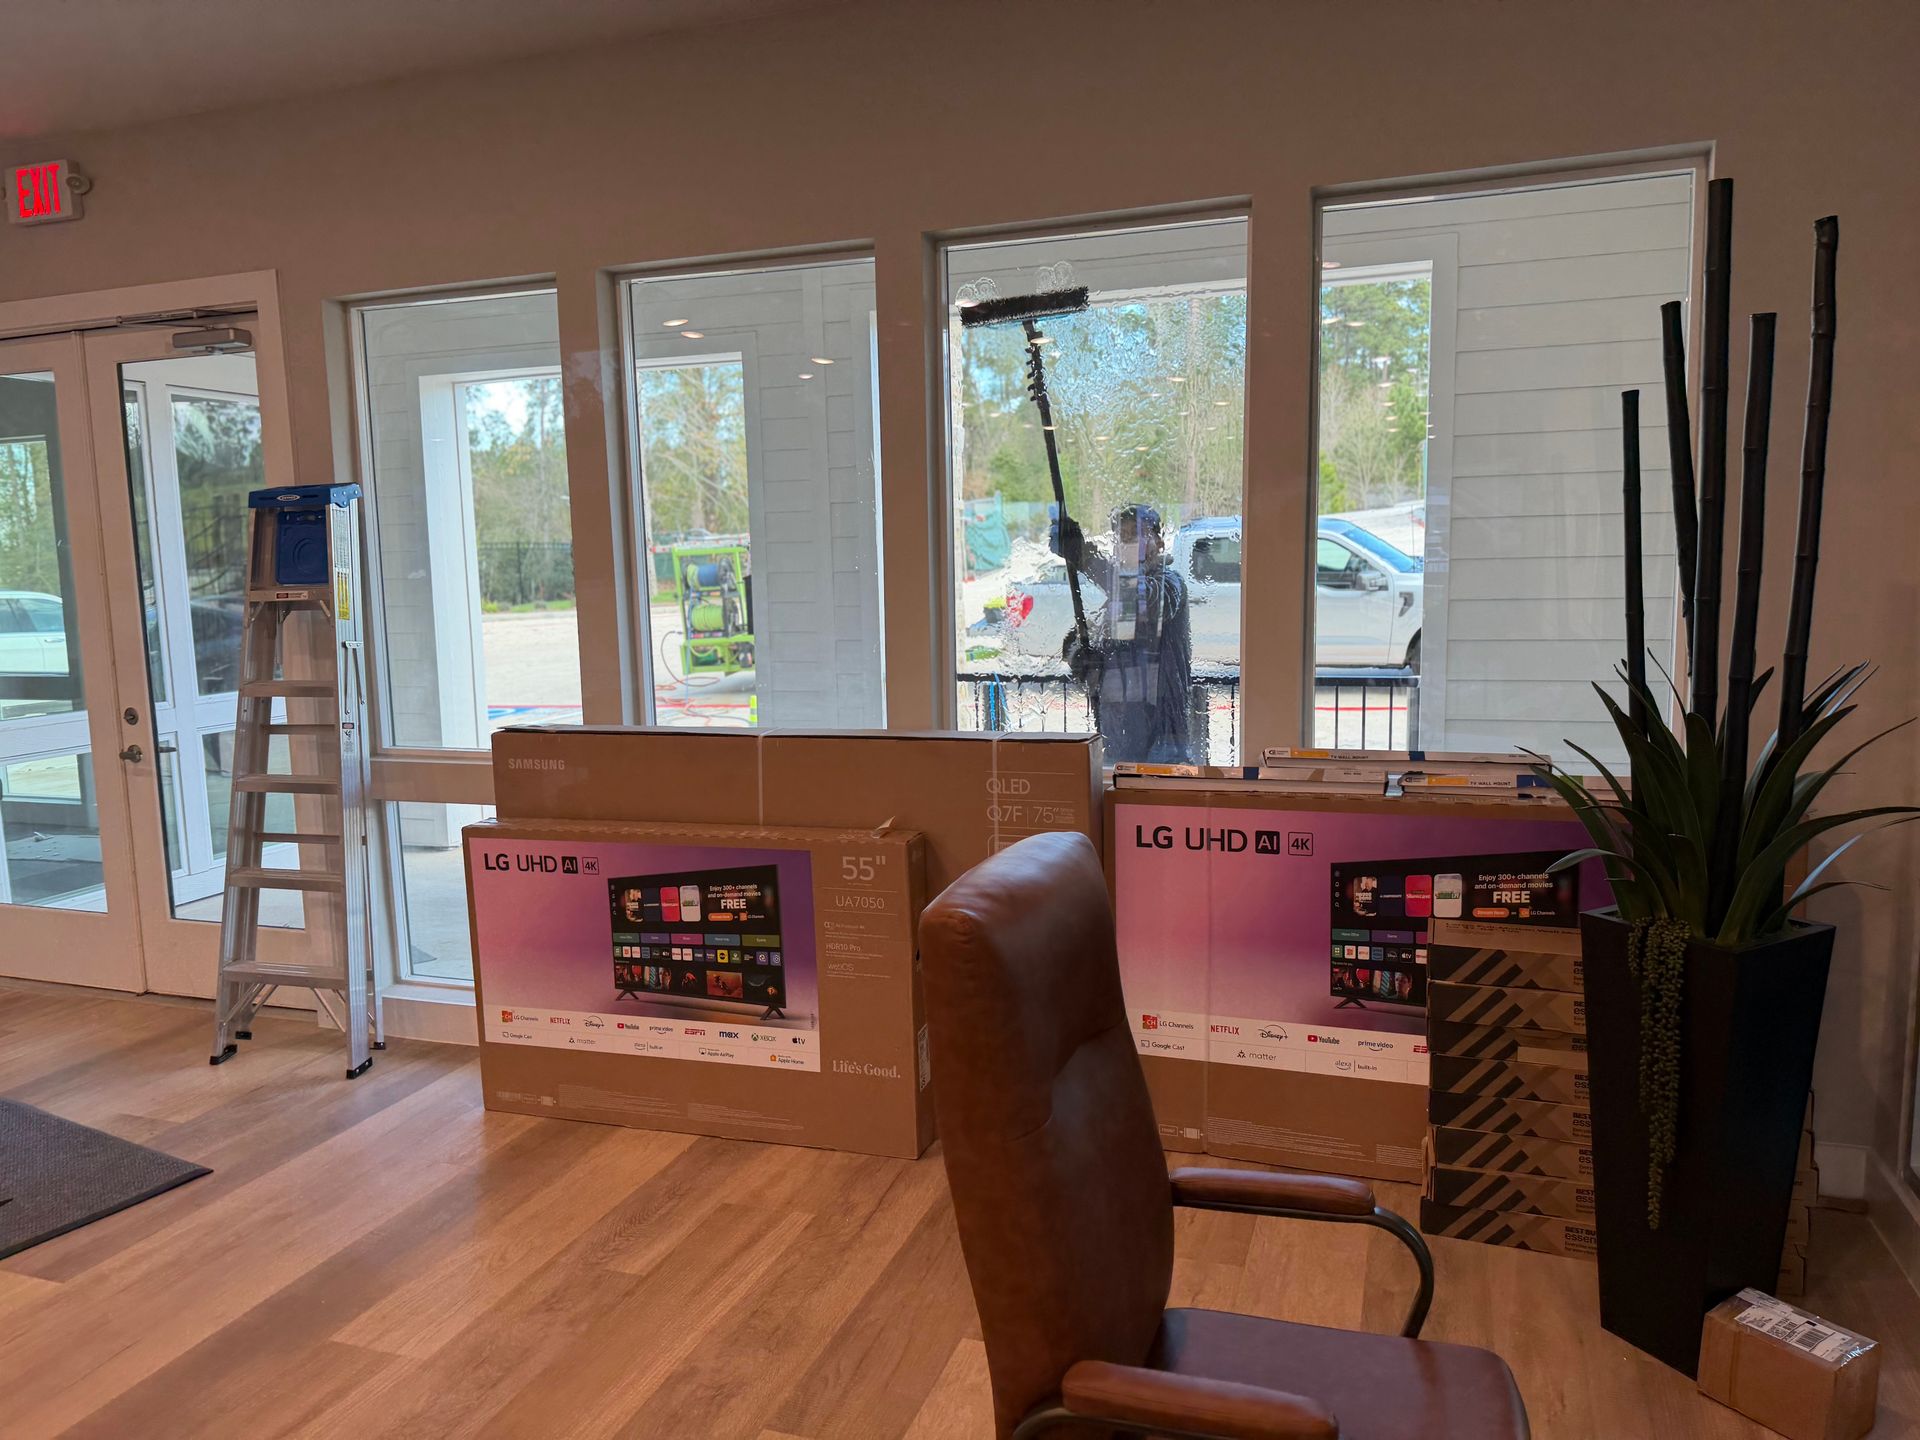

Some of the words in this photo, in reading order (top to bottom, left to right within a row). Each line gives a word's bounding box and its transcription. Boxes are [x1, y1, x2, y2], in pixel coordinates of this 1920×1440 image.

[16, 163, 61, 218] EXIT
[508, 758, 565, 770] SAMSUNG
[986, 778, 1030, 795] QLED
[987, 805, 1022, 822] Q7F
[1136, 825, 1173, 849] LG
[1185, 827, 1248, 852] UHD
[1257, 834, 1277, 850] AI
[1291, 838, 1310, 851] 4K
[484, 853, 510, 871] LG
[516, 854, 557, 873] UHD
[564, 859, 577, 872] AI
[584, 861, 597, 871] 4K
[842, 856, 886, 881] 55"
[1478, 874, 1496, 882] Enjoy
[1516, 872, 1549, 880] channels
[836, 896, 885, 910] UA7050
[1492, 890, 1530, 904] FREE
[720, 898, 747, 910] FREE
[550, 1016, 571, 1025] NETFLIX
[1168, 1022, 1194, 1030] Channels
[719, 1031, 739, 1039] max
[1210, 1025, 1240, 1036] NETFLIX
[1258, 1026, 1288, 1041] Disney+
[1152, 1042, 1172, 1050] Google
[1318, 1036, 1340, 1045] YouTube
[1377, 1040, 1394, 1049] video
[1413, 1045, 1428, 1054] ES
[1249, 1052, 1277, 1061] matter
[832, 1060, 862, 1075] Life's
[864, 1064, 901, 1078] Good.
